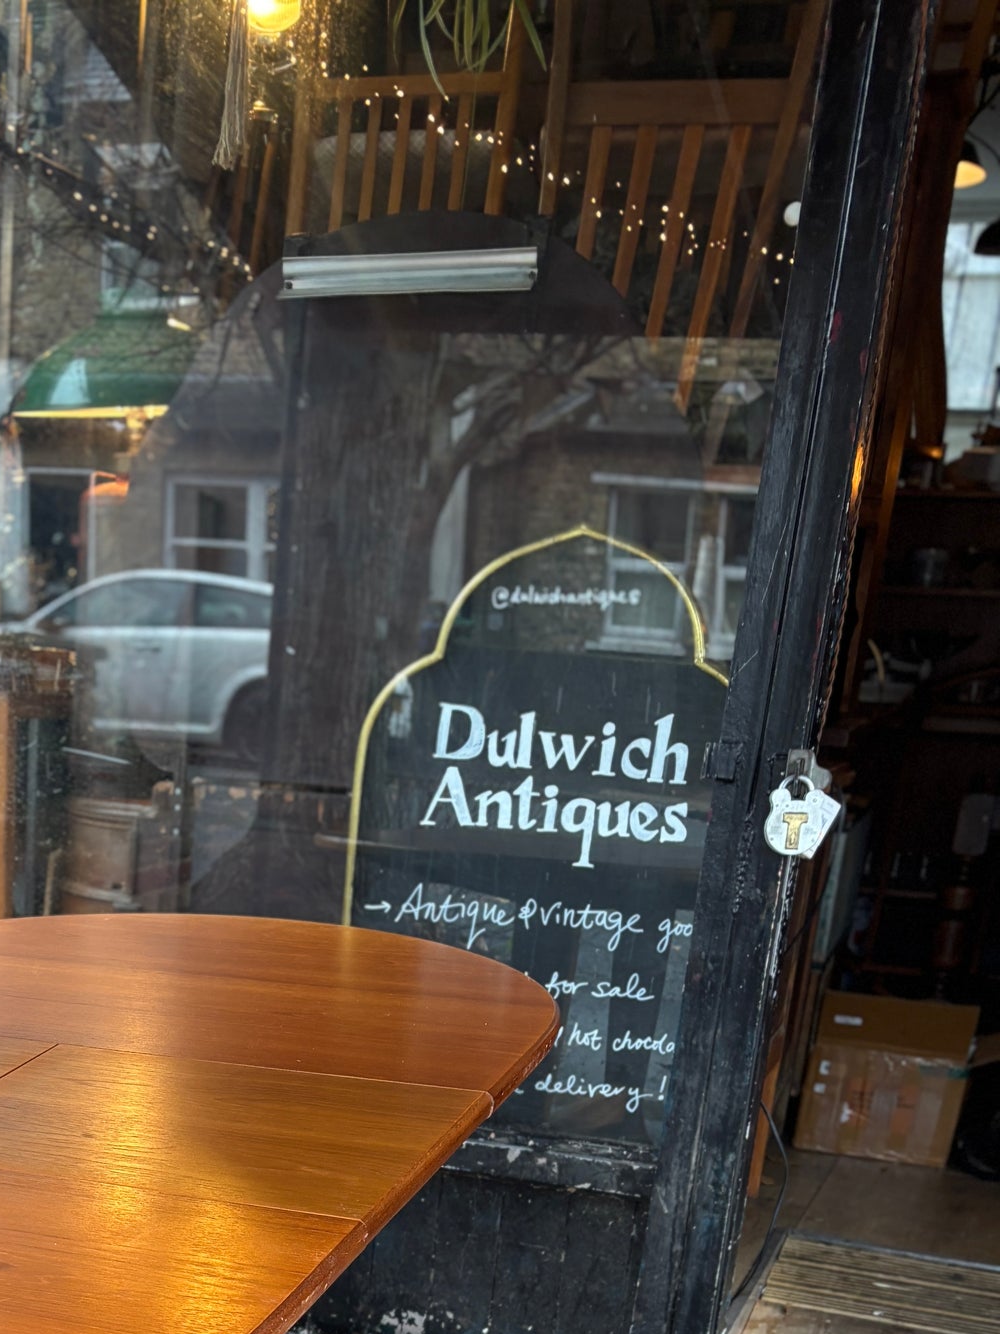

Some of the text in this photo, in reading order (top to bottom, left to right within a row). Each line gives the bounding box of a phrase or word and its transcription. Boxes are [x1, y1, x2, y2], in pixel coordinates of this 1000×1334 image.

[432, 702, 690, 785] Dulwich
[419, 766, 689, 869] Antiques
[394, 882, 516, 950] Antique
[545, 971, 655, 1001] for sale
[567, 1022, 602, 1050] hot
